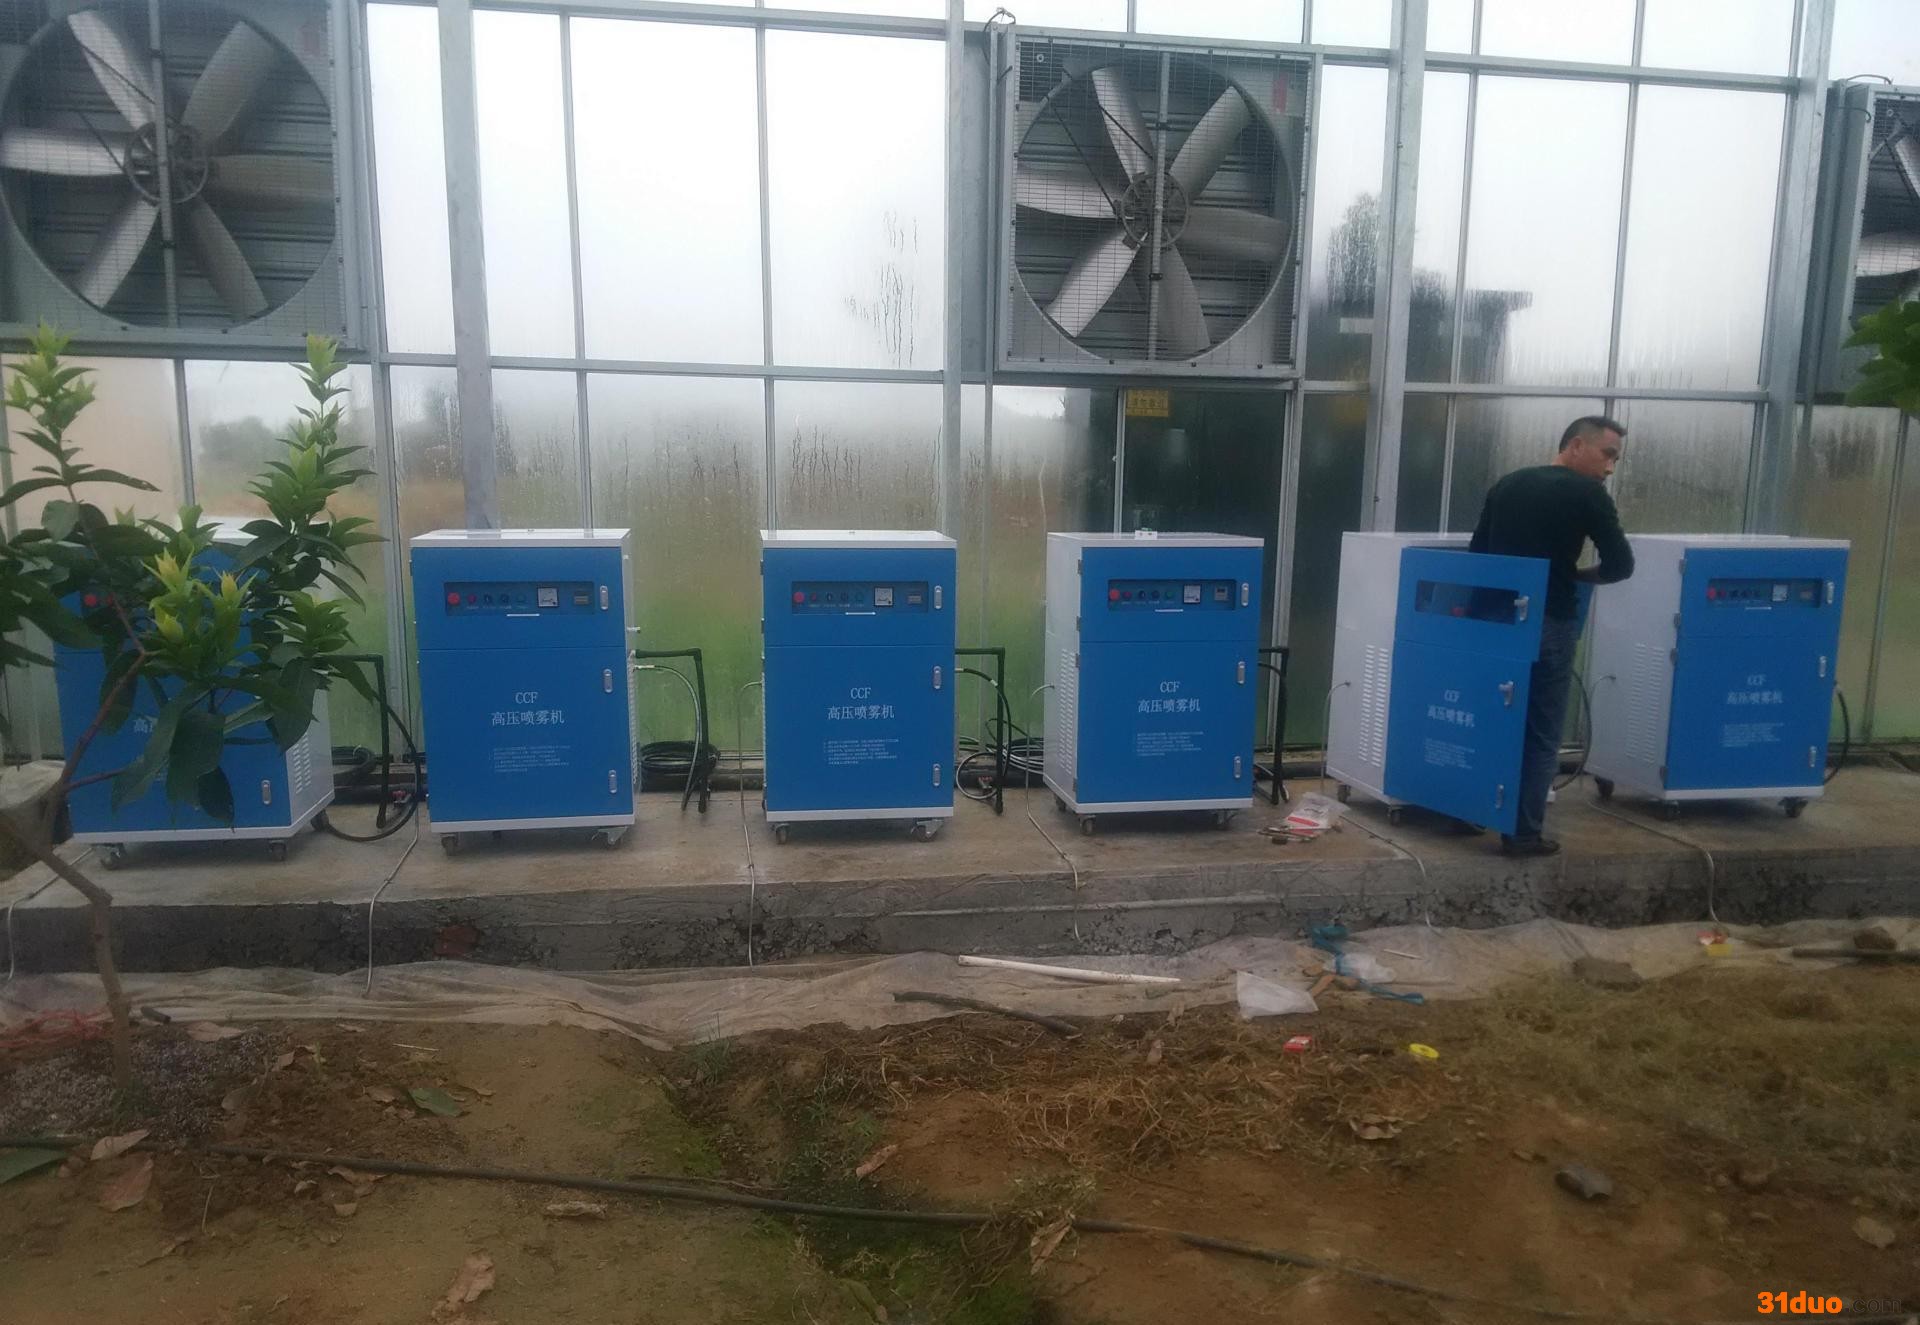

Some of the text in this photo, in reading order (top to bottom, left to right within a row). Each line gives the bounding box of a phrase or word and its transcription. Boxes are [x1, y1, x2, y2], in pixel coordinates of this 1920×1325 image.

[1747, 674, 1767, 686] CCF
[850, 687, 872, 699] CCF
[1160, 681, 1180, 693] CCF
[515, 691, 538, 704] CCF
[827, 704, 895, 720] 高压喷雾机
[1138, 698, 1201, 713] 高压喷雾机
[491, 710, 565, 726] 高压喷雾机
